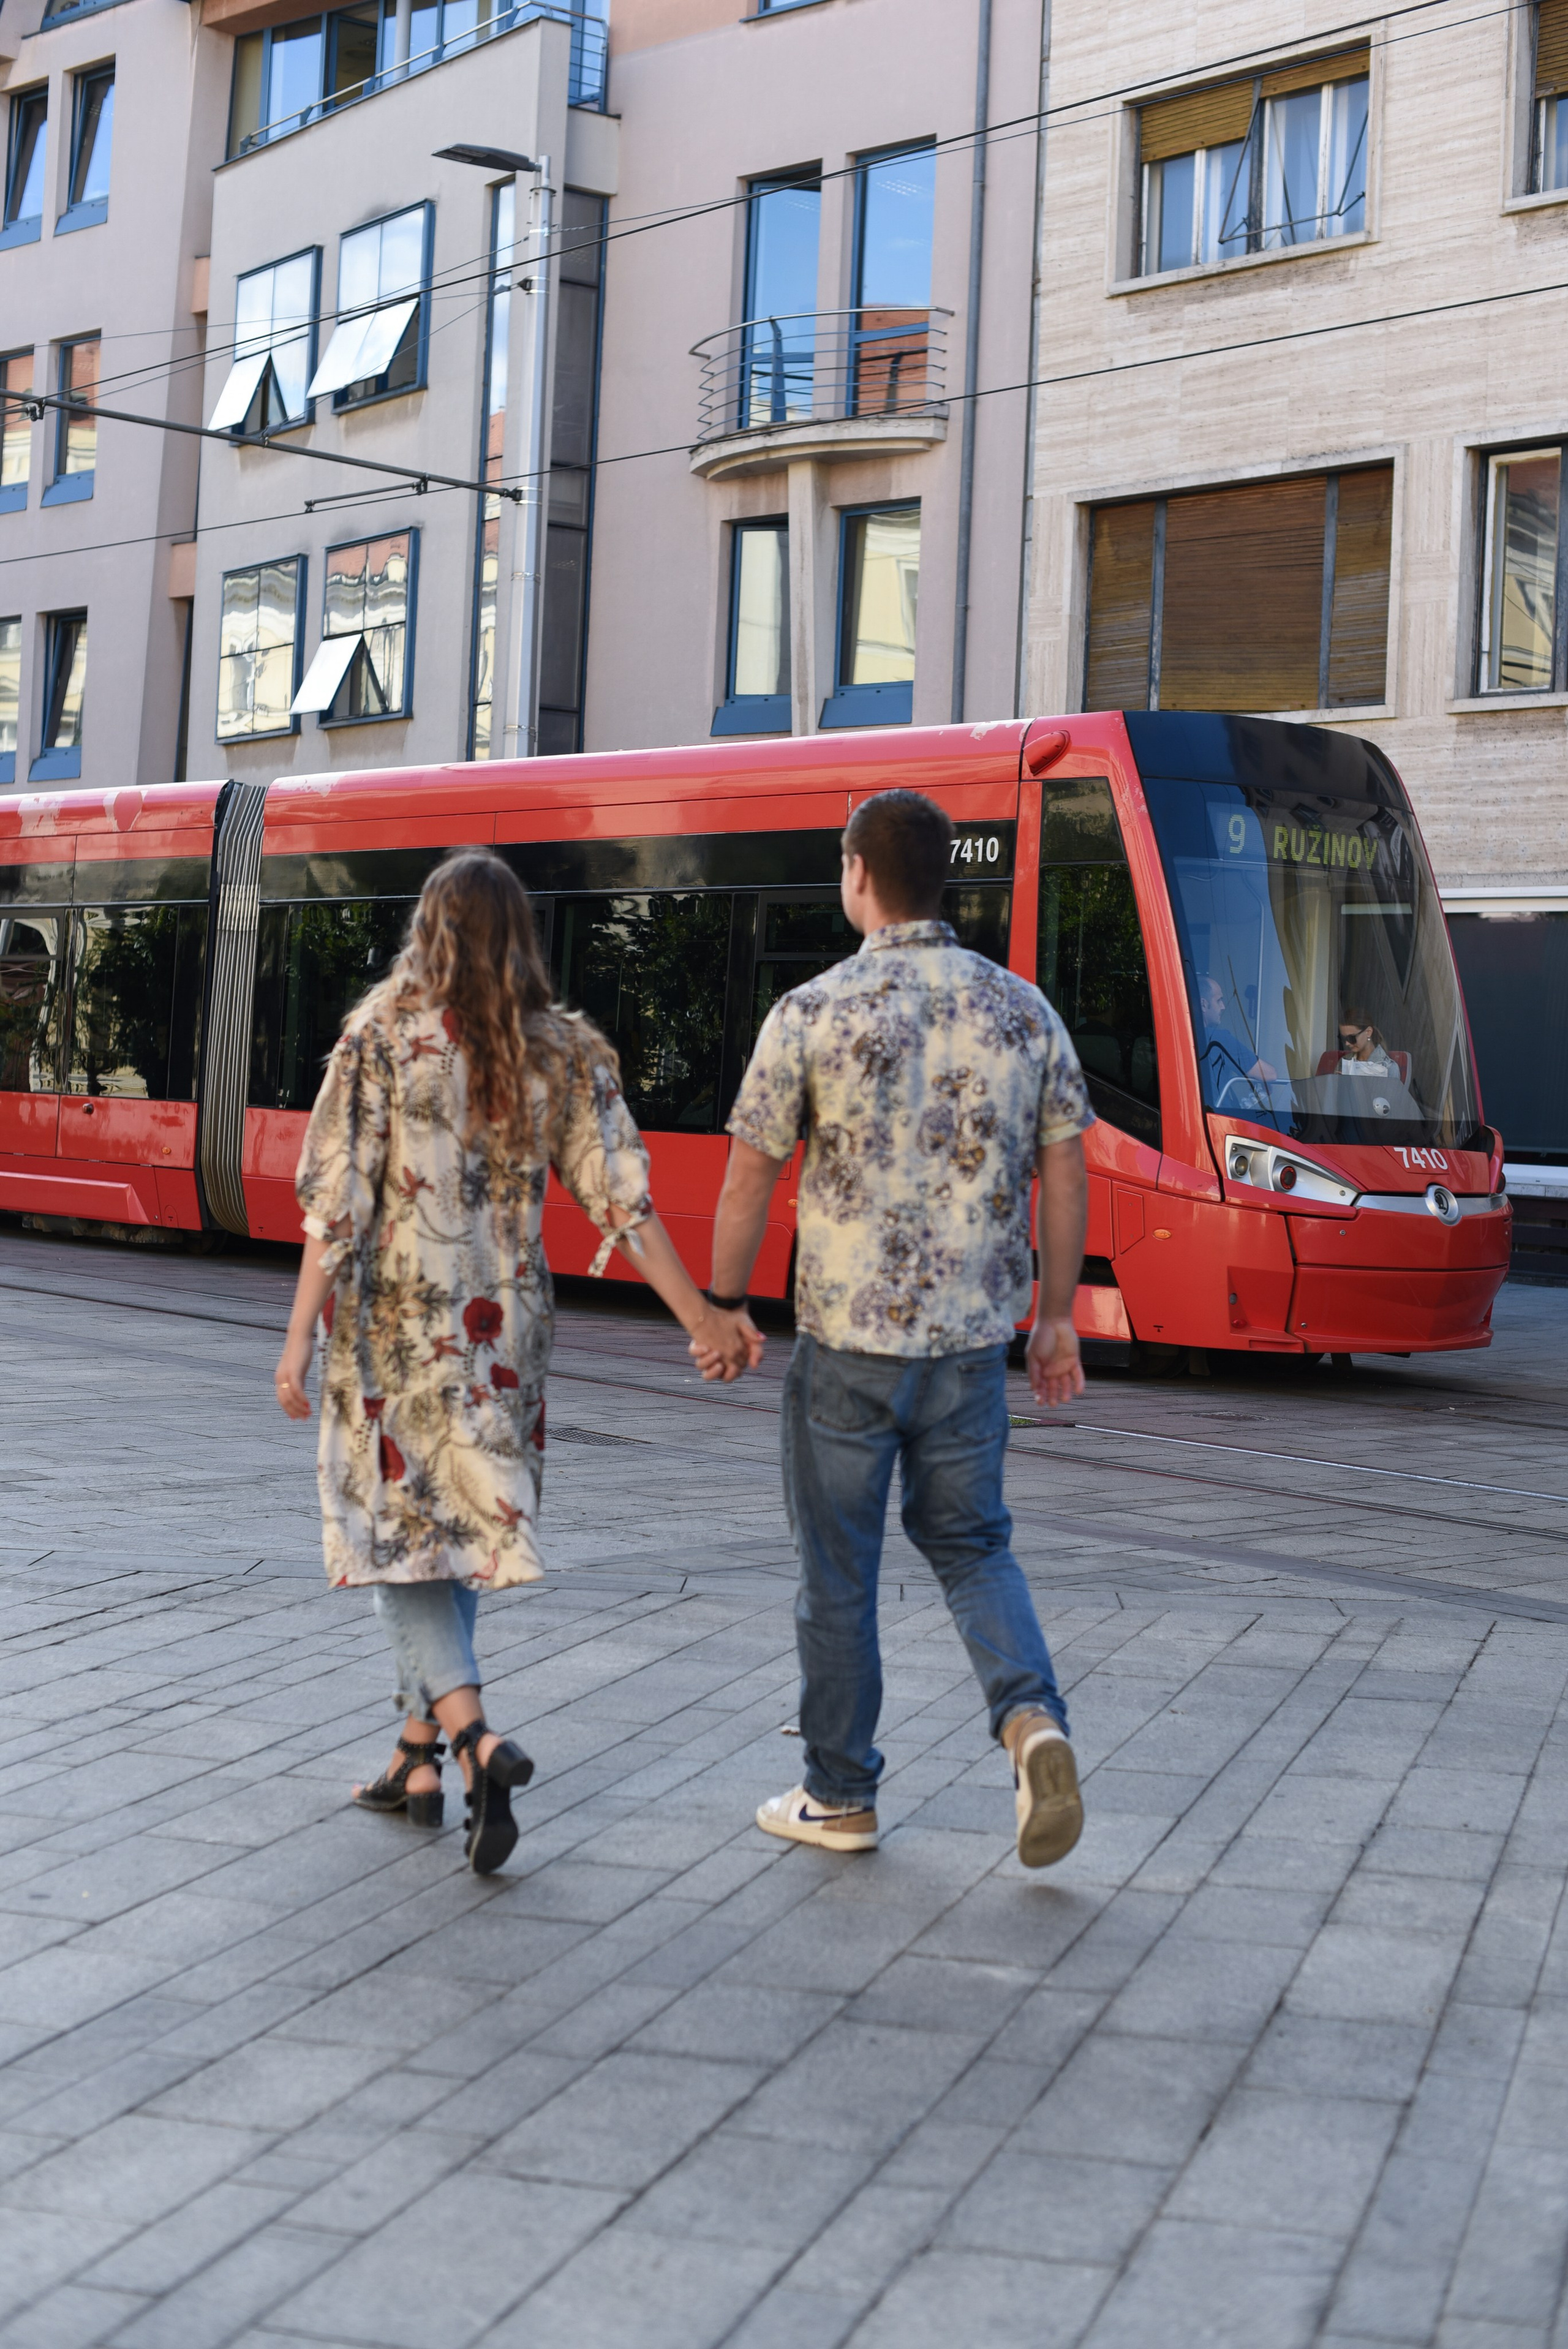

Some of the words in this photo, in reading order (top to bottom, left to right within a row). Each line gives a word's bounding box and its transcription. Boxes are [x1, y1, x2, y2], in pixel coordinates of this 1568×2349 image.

[950, 837, 999, 864] 7410
[1229, 814, 1246, 854] 9
[1273, 824, 1379, 870] RUŽINOV
[1393, 1147, 1448, 1170] 7410
